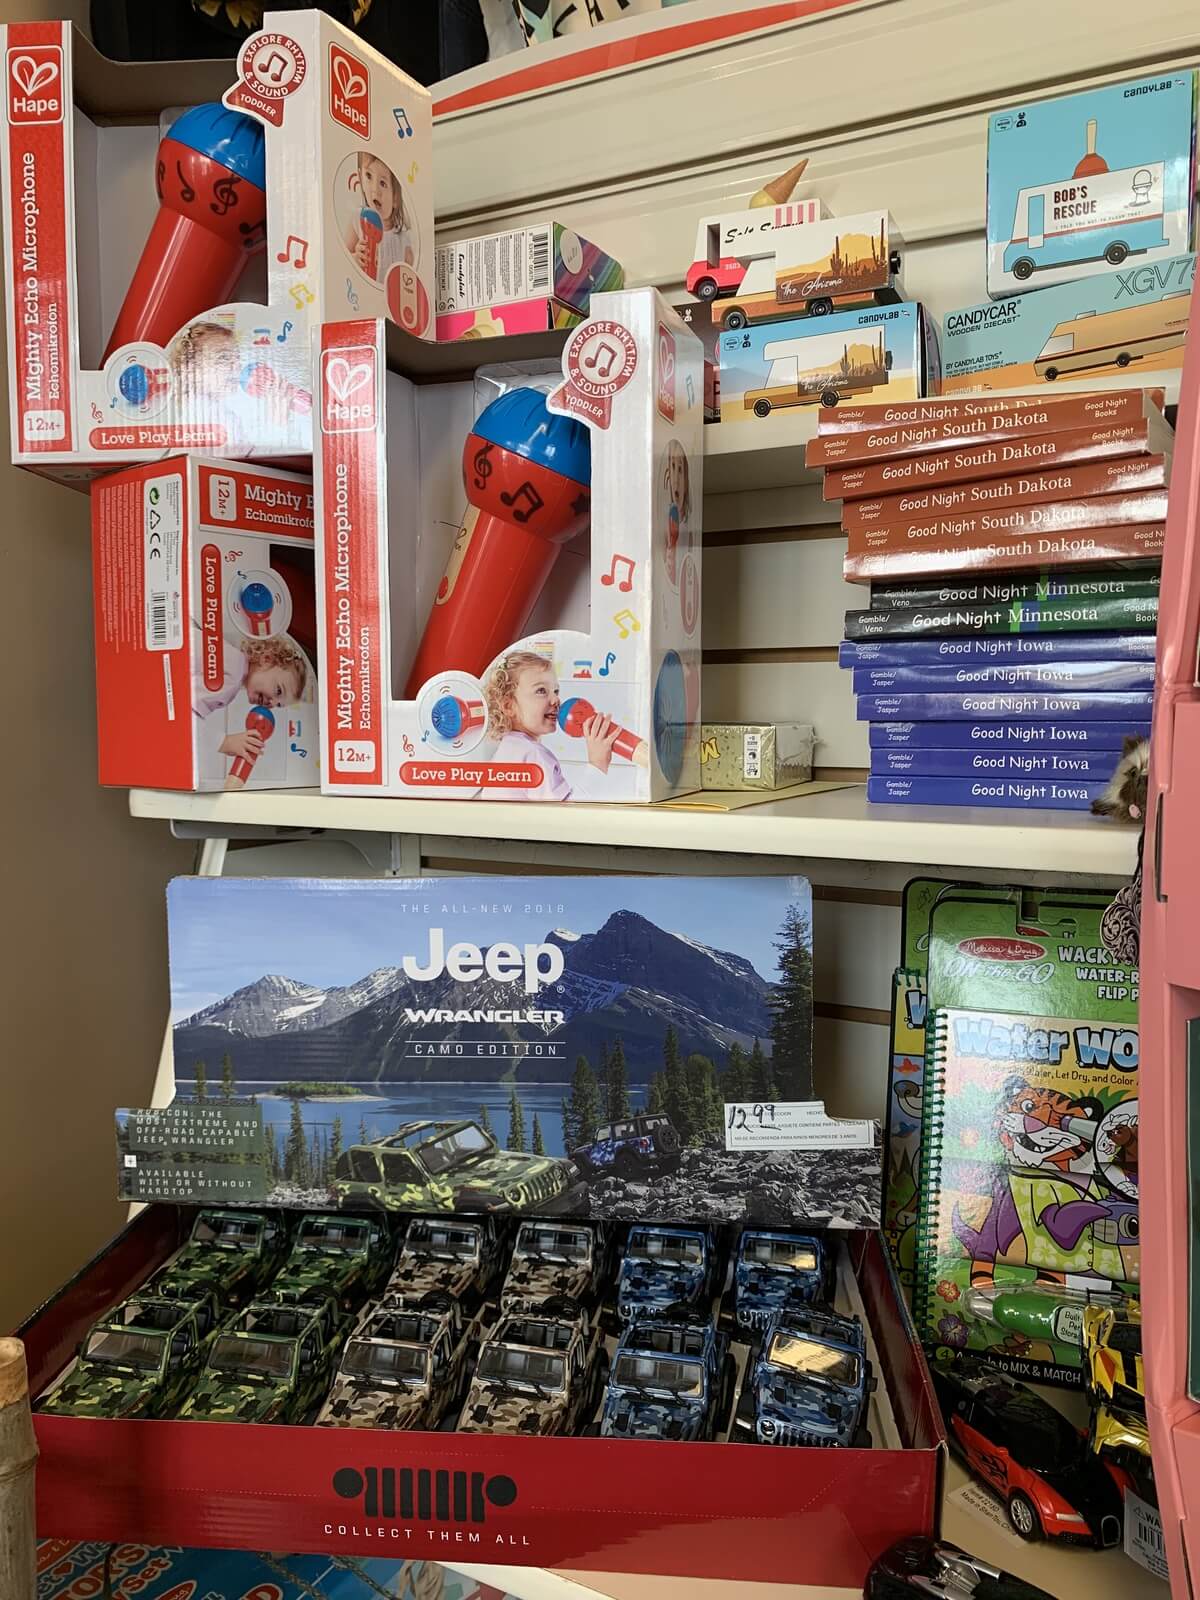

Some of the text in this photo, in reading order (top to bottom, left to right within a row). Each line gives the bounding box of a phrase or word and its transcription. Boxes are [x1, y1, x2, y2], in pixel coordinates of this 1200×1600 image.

[244, 35, 283, 63] EXPLORE
[285, 39, 305, 84] RHYTHM
[251, 80, 289, 97] SOUND
[13, 97, 59, 114] Hape
[240, 94, 277, 117] TODDLER
[333, 94, 367, 128] Hape
[1054, 186, 1088, 204] BOB'S
[1054, 200, 1097, 220] RESCUE
[21, 152, 43, 401] Mighty Echo Microphone
[780, 273, 844, 296] The Arizona
[947, 325, 981, 337] WOODEN
[570, 323, 612, 358] EXPLORE
[47, 303, 60, 400] Echomikrofon
[614, 327, 636, 377] RHYTHM
[577, 378, 617, 395] SOUND
[565, 395, 604, 418] TODDLER
[1085, 398, 1128, 411] Good Night
[326, 403, 371, 424] Hape
[884, 405, 959, 422] Good Night
[1095, 409, 1117, 418] Books
[101, 431, 217, 446] Love Play Learn
[867, 412, 1048, 448] Good Night South Dakota
[1092, 427, 1134, 441] Good Night
[824, 440, 849, 449] Gamble/
[825, 448, 847, 457] Jasper
[882, 442, 1057, 480] Good Night South Dakota
[244, 483, 302, 511] Mighty
[900, 476, 1072, 511] Good Night South Dakota
[244, 507, 314, 529] Echomikrofo
[907, 506, 1086, 538] Good Night South Dakota
[1134, 532, 1154, 540] Good
[987, 537, 1096, 557] South Dakota
[334, 463, 355, 730] Mighty Echo Microphone
[939, 581, 1126, 602] Good Night Minnesota
[891, 599, 910, 607] Veno
[205, 557, 218, 679] Love Play Learn
[859, 615, 890, 624] Gamble/
[912, 608, 1098, 629] Good Night Minnesota
[864, 625, 883, 633] Veno
[939, 639, 1054, 656] Good Night Iowa
[858, 652, 880, 661] Jasper
[359, 626, 371, 729] Echomikrofon
[956, 669, 1074, 684] Good Night Iowa
[962, 698, 1081, 713] Good Night Iowa
[971, 727, 1088, 743] Good Night Iowa
[338, 748, 371, 763] 12M+
[973, 755, 1090, 771] Good Night Iowa
[412, 768, 532, 784] Love Play Learn
[886, 781, 912, 789] Gamble/
[888, 788, 910, 797] Jasper
[971, 784, 1089, 800] Good Night Iowa
[401, 904, 565, 914] THE ALL-NEW 2018
[402, 928, 565, 994] Jeep
[1097, 986, 1128, 1000] FLIP
[404, 1008, 567, 1024] WRANGLER
[954, 1017, 1069, 1065] Water
[415, 1044, 557, 1056] CAMO EDITION
[1055, 1071, 1070, 1080] Let
[1071, 1072, 1090, 1084] Dry,
[1092, 1074, 1109, 1084] and
[1110, 1076, 1135, 1087] Color
[136, 1118, 258, 1128] MOST EXTREME AND
[137, 1127, 256, 1137] OFF-ROAD CAPABLE
[172, 1137, 235, 1145] WRANGLER
[138, 1169, 204, 1178] AVAILABLE
[139, 1179, 169, 1187] WITH
[198, 1180, 252, 1189] WITHOUT
[140, 1188, 193, 1196] HARDTOP
[1000, 1360, 1009, 1371] to
[1010, 1361, 1031, 1375] MIX
[1032, 1366, 1041, 1377] &
[1043, 1368, 1082, 1384] MATCH
[324, 1524, 530, 1545] COLLECT THEM ALL
